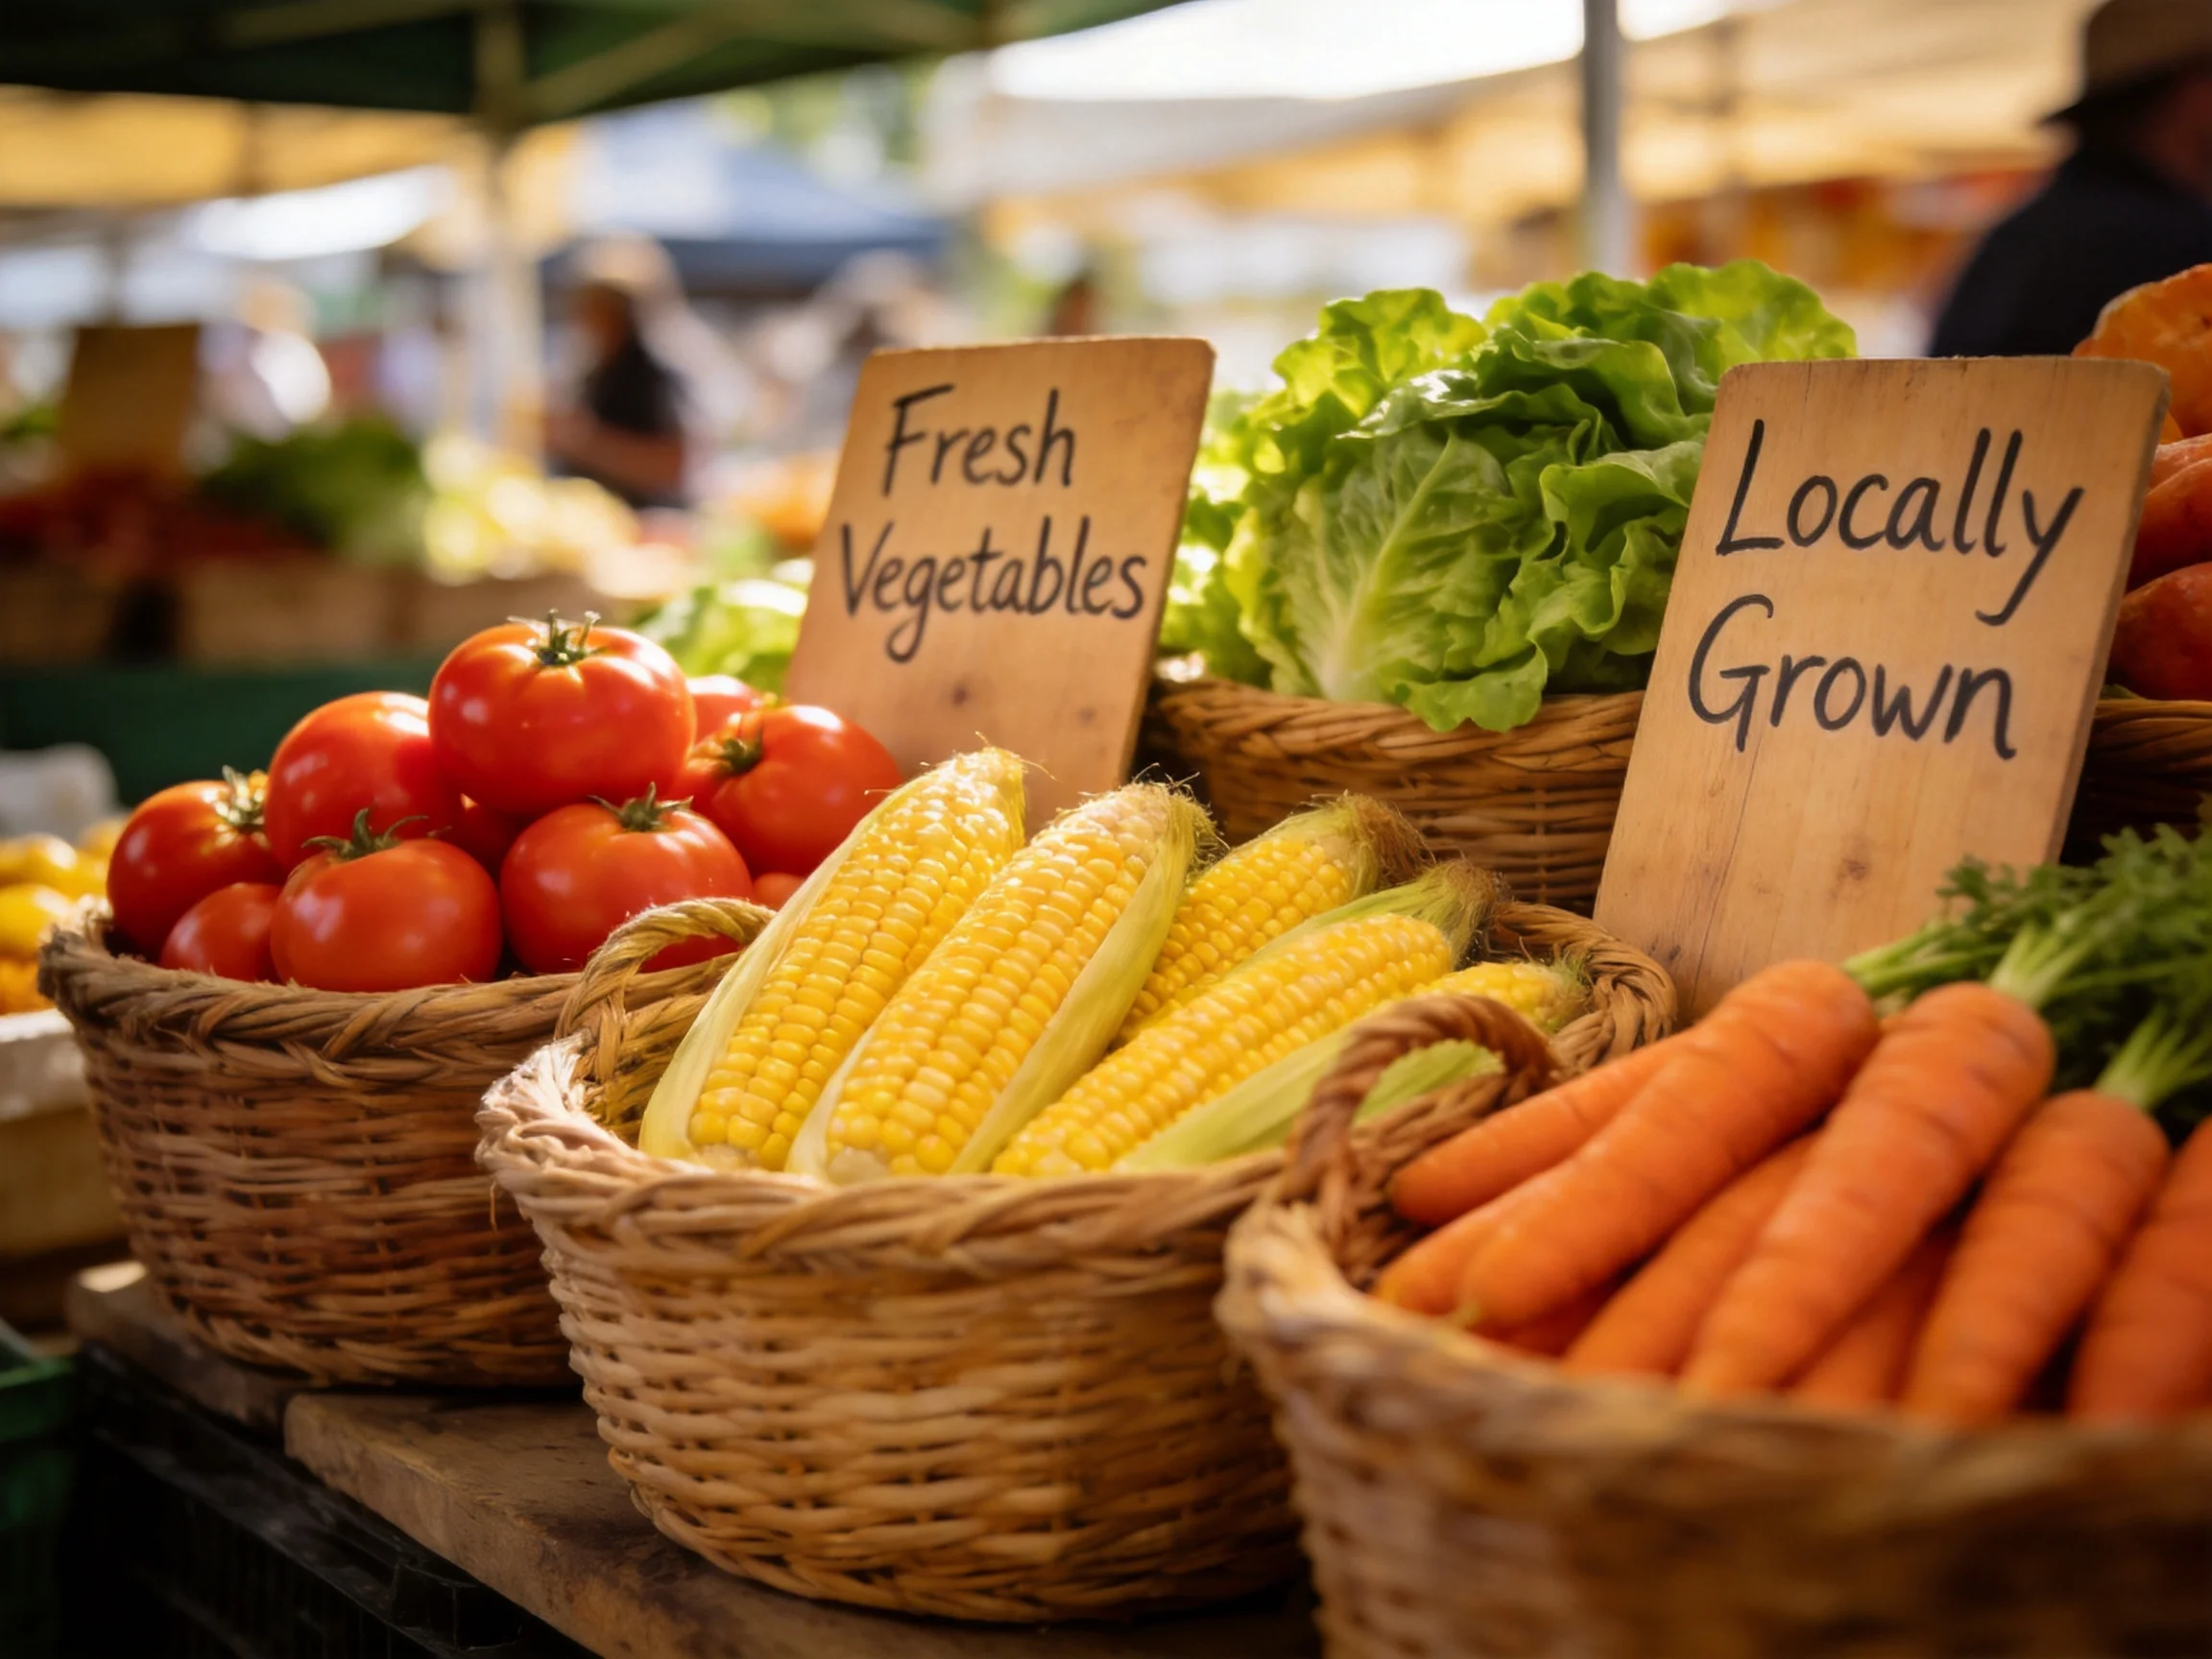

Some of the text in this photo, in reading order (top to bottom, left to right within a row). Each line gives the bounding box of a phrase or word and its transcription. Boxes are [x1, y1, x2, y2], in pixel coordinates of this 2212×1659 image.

[881, 383, 1075, 496] Fresh
[840, 517, 1147, 663] Vegetables
[1715, 419, 2085, 627] Locally
[1688, 593, 2017, 760] Grown
